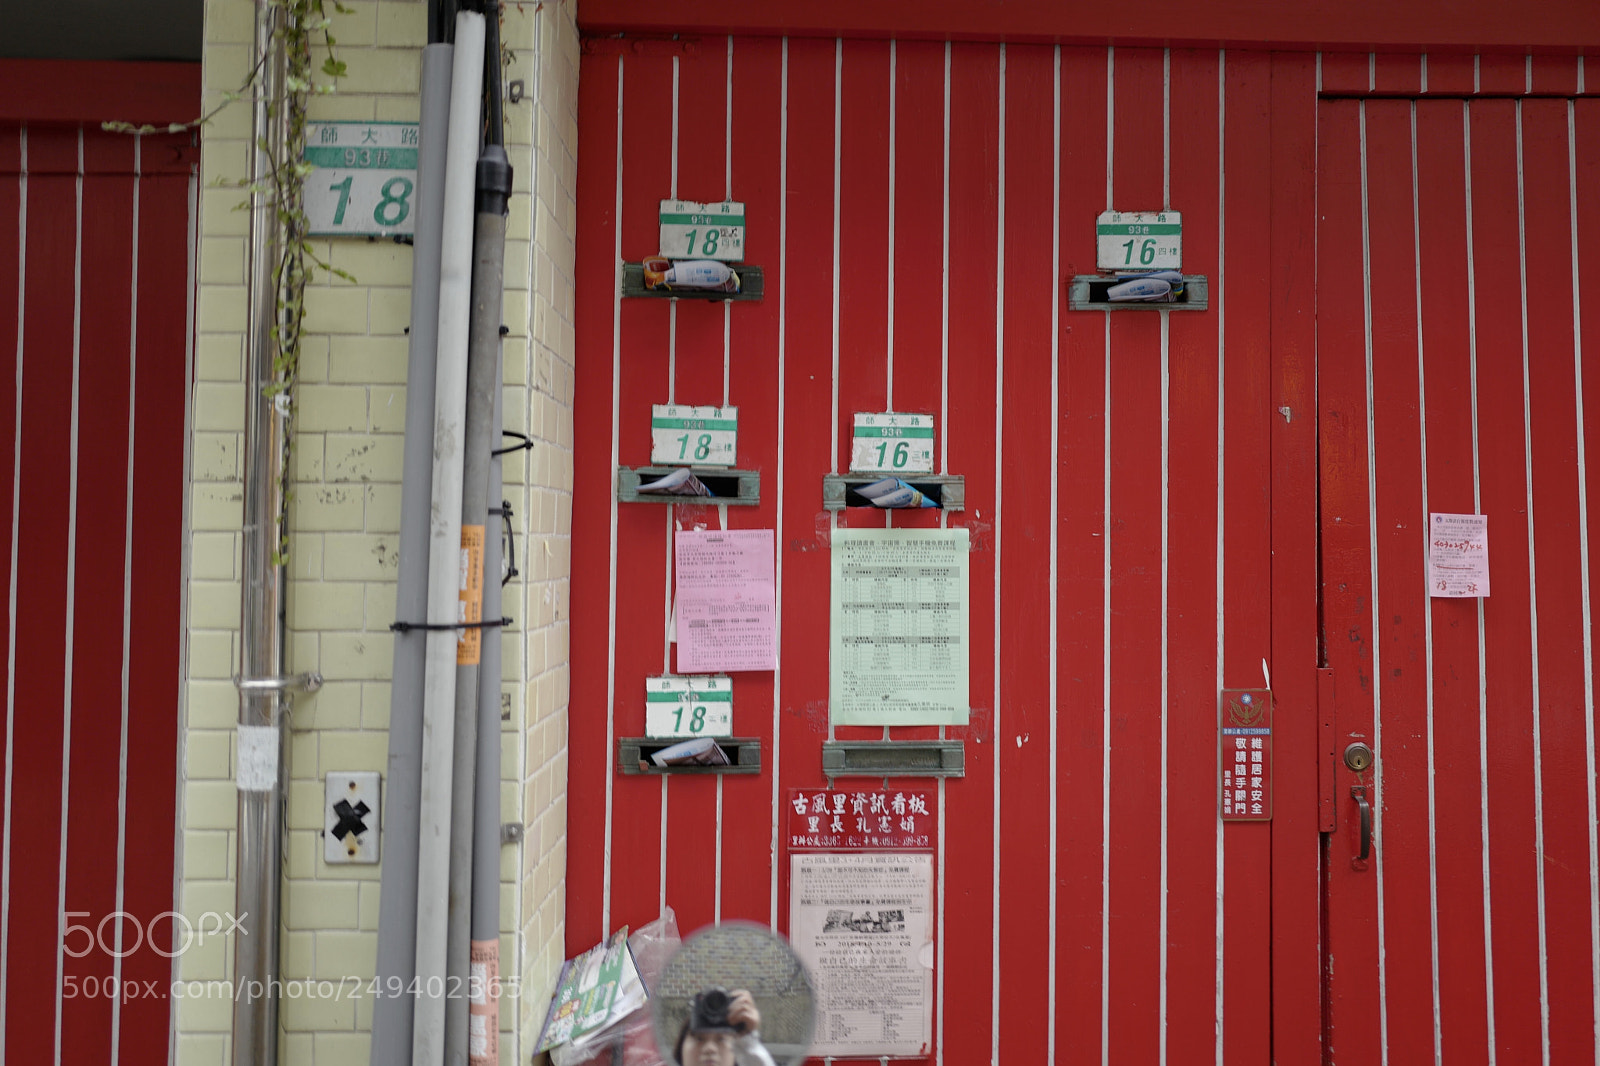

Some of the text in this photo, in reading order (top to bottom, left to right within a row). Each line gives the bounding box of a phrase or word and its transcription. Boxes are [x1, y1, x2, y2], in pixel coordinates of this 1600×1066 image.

[321, 127, 418, 145] 師大路
[344, 148, 390, 167] 93巷
[329, 176, 413, 226] 18
[685, 228, 720, 255] 18
[1122, 238, 1157, 265] 16
[865, 416, 920, 426] 師大路
[677, 433, 712, 460] 18
[875, 441, 910, 468] 16
[672, 706, 707, 733] 18
[1235, 737, 1247, 815] 敬請隨手關門
[1251, 737, 1263, 815] 維護居家安全
[792, 792, 929, 815] 古風里資訊看板
